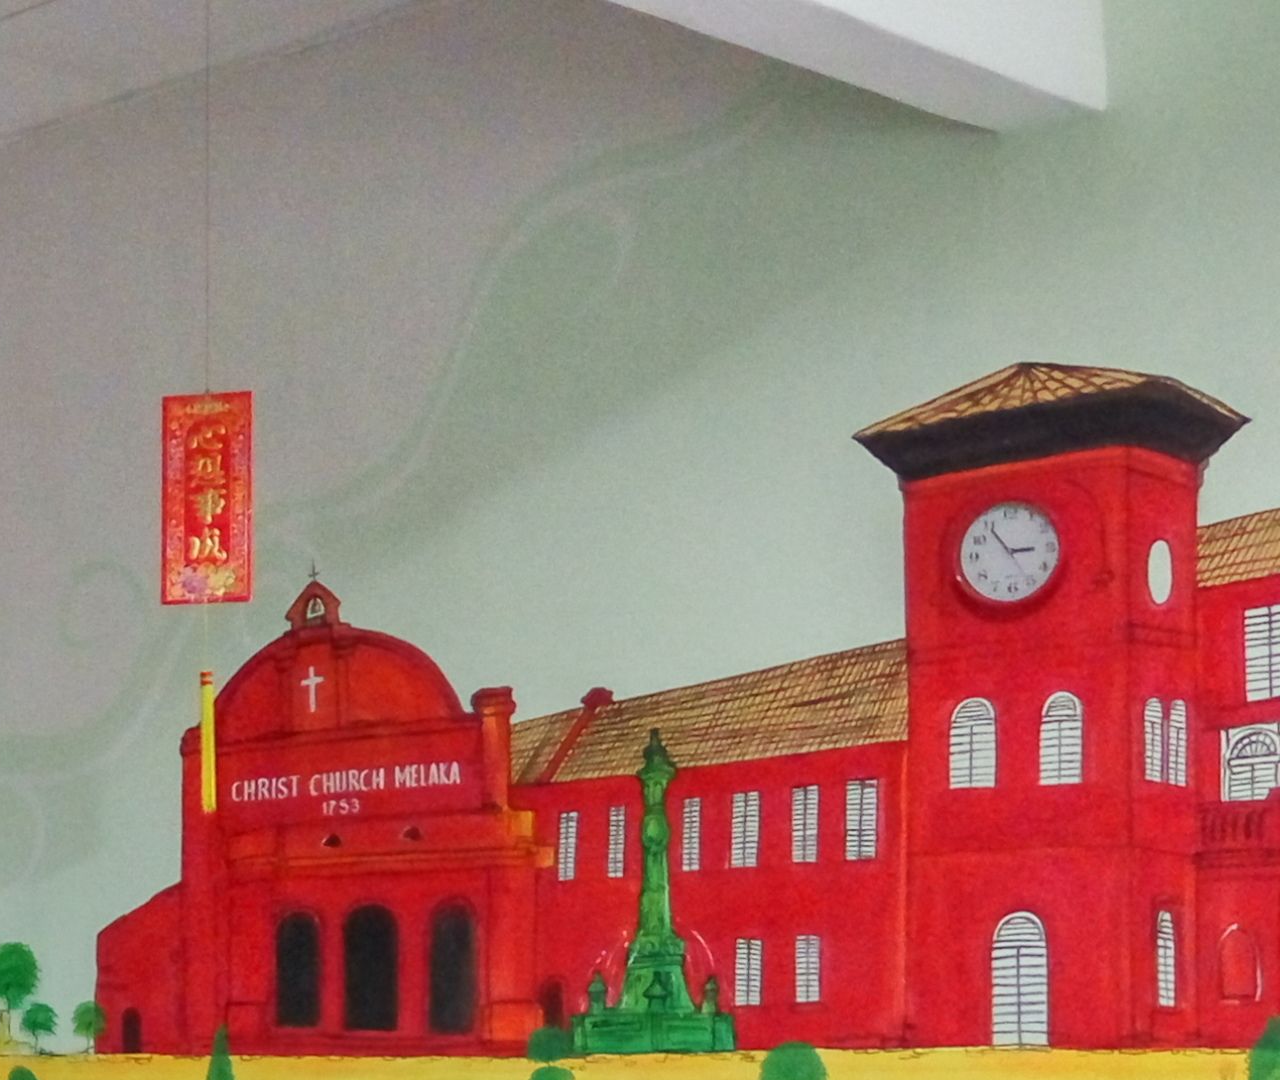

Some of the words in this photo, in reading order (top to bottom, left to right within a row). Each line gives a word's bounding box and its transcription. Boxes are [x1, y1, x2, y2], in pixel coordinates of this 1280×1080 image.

[231, 774, 300, 802] CHRIST
[309, 768, 385, 796] CHURCH
[395, 761, 461, 788] MELAKA
[322, 798, 360, 816] 1753
